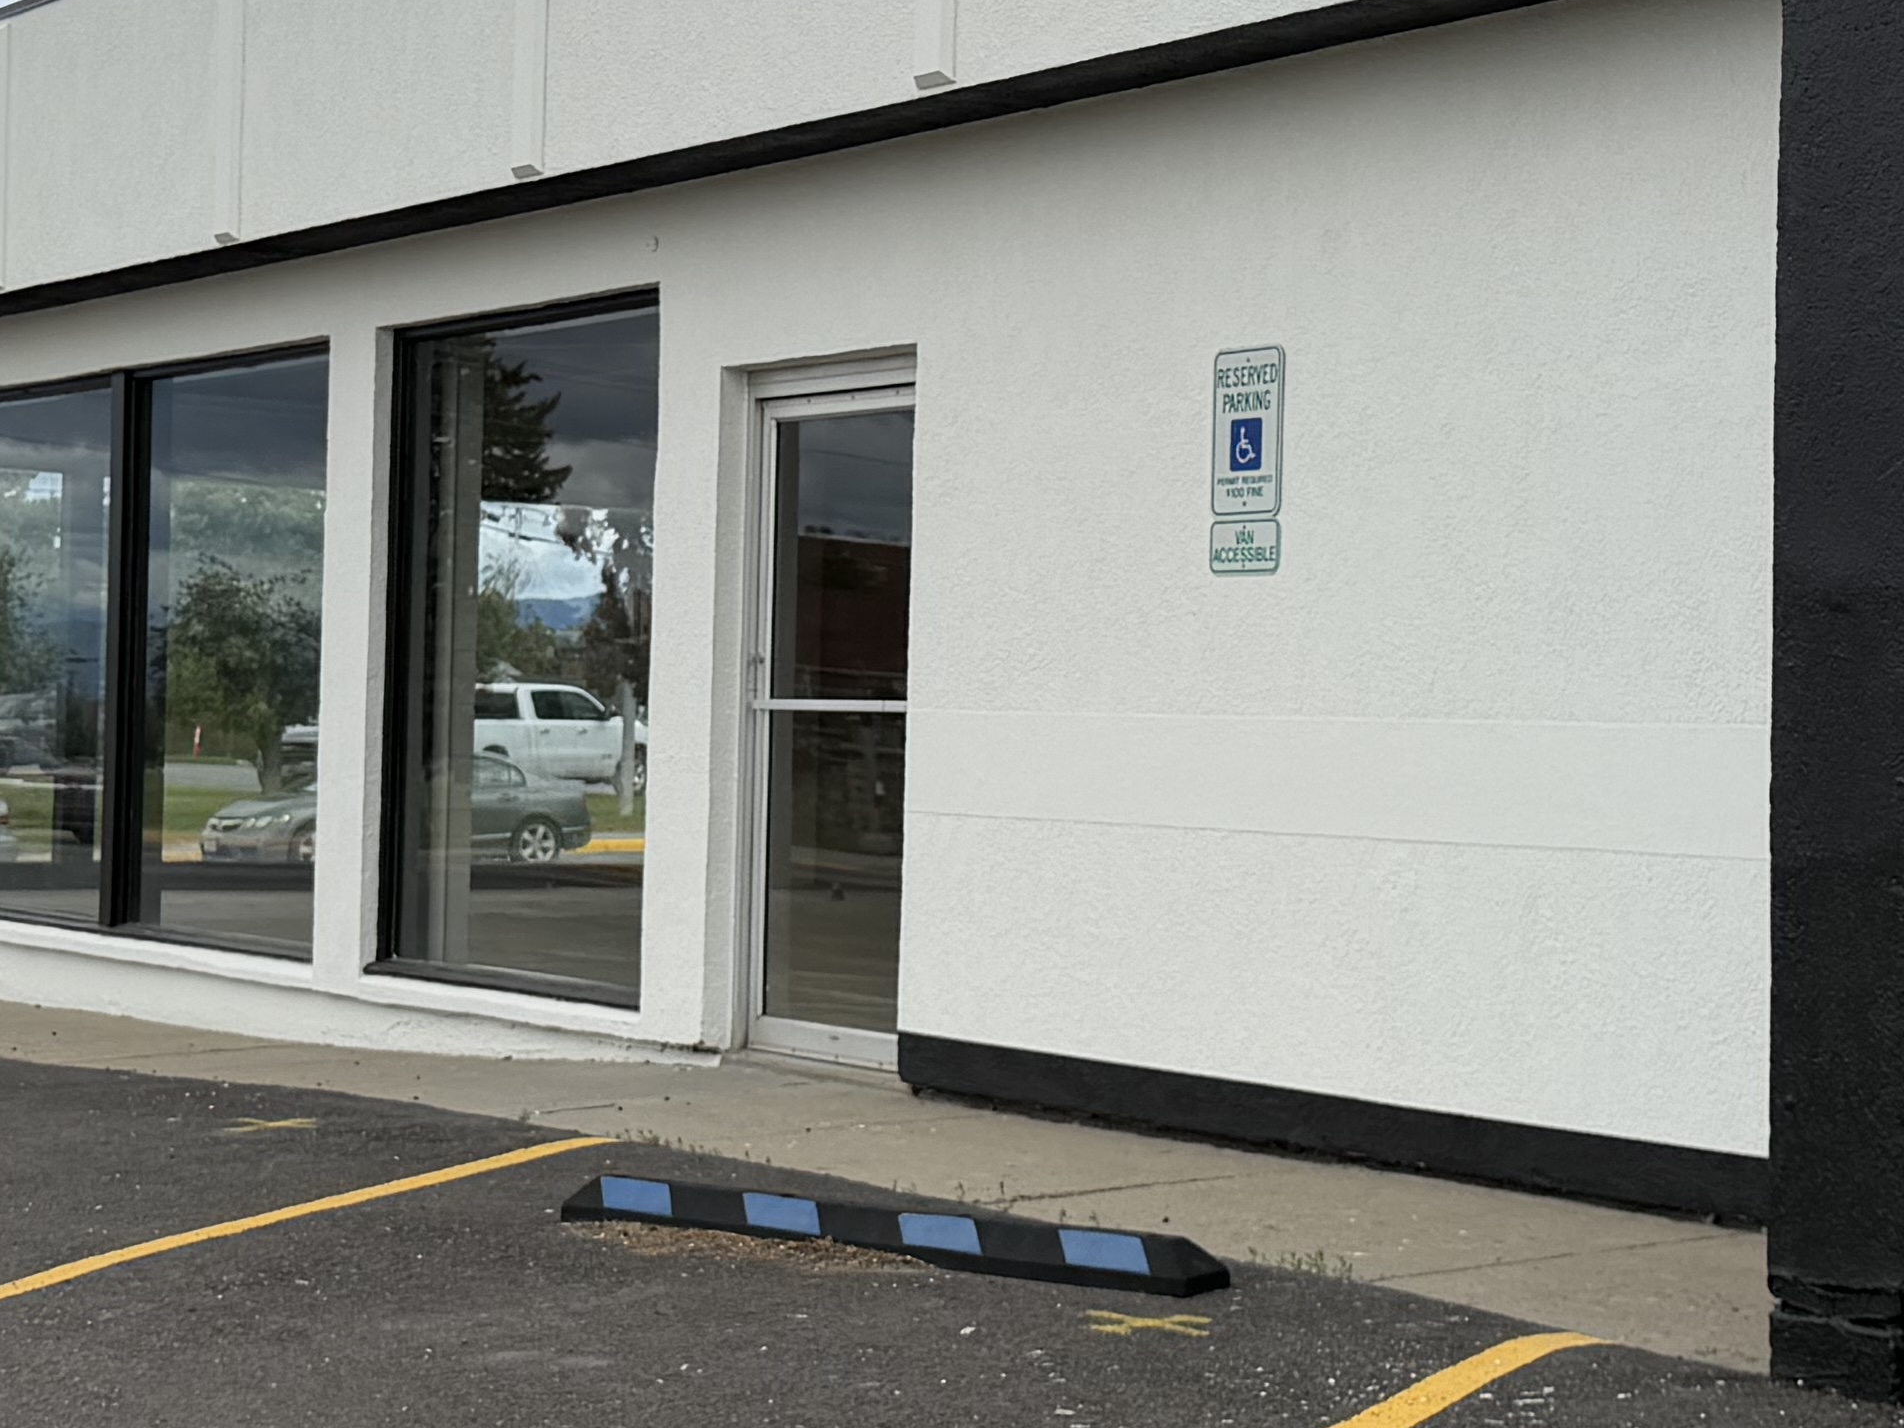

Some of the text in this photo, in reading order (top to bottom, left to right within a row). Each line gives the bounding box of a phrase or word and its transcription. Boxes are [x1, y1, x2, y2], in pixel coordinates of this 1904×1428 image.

[1217, 363, 1278, 389] RESERVED
[1222, 390, 1271, 414] PARKING
[1246, 485, 1264, 497] FINE
[1234, 530, 1255, 545] VAN
[1213, 546, 1276, 563] ACCESSIBLE
